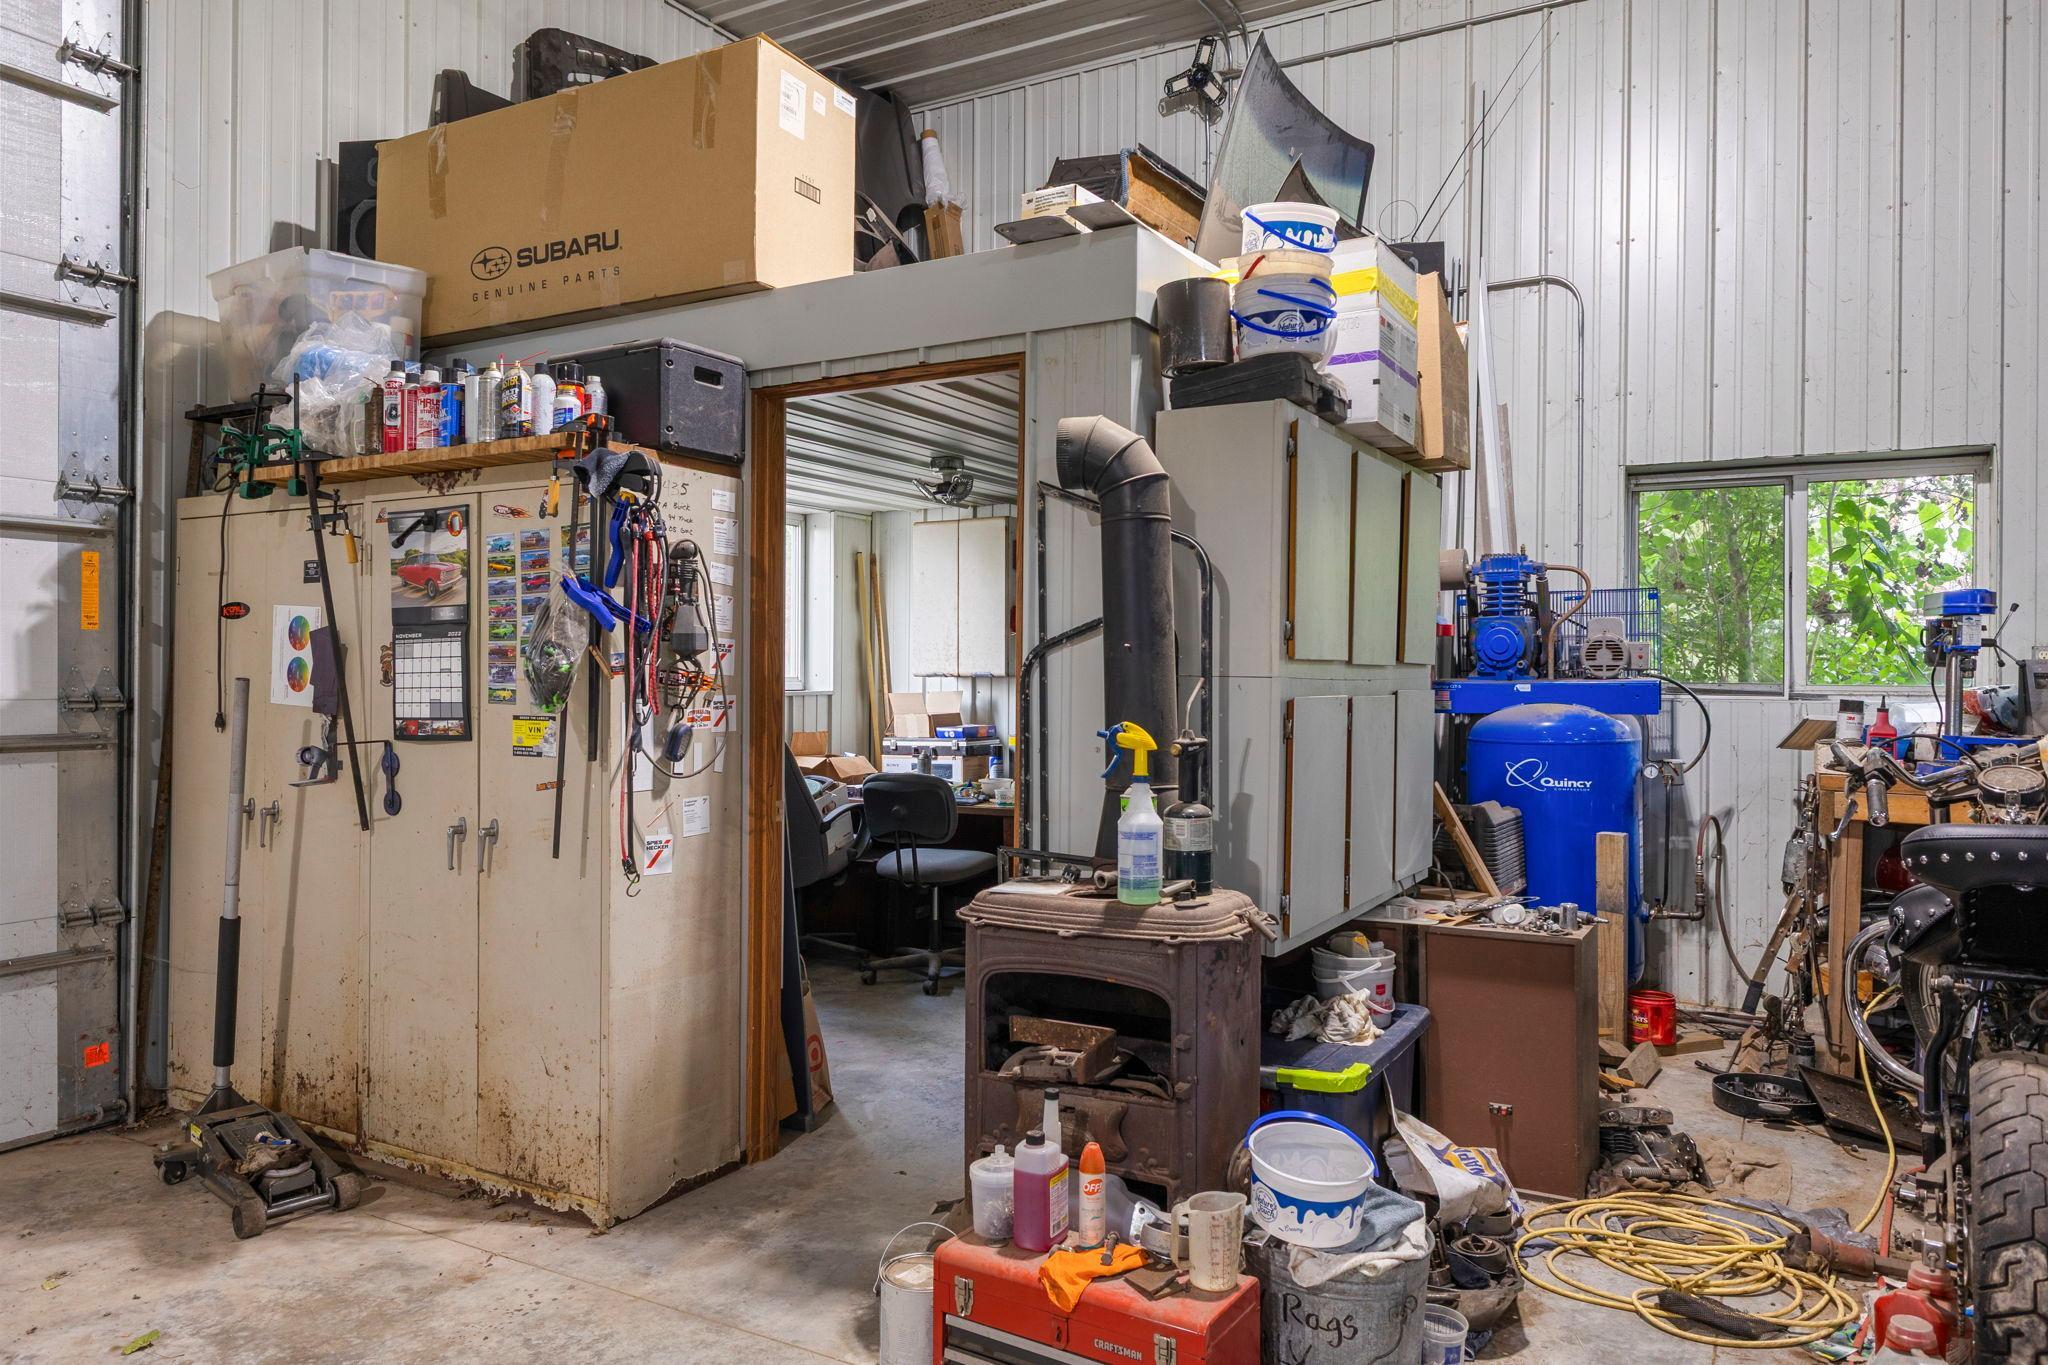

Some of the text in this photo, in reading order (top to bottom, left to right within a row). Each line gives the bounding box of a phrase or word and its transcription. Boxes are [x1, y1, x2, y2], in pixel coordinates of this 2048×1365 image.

[516, 229, 620, 268] SUBARU
[472, 266, 621, 302] GENUINE PARTS
[1540, 777, 1592, 788] Quincy
[1083, 1183, 1103, 1193] OFF!
[1282, 1292, 1359, 1348] Rags
[1094, 1338, 1142, 1361] CRAFTSMAN
